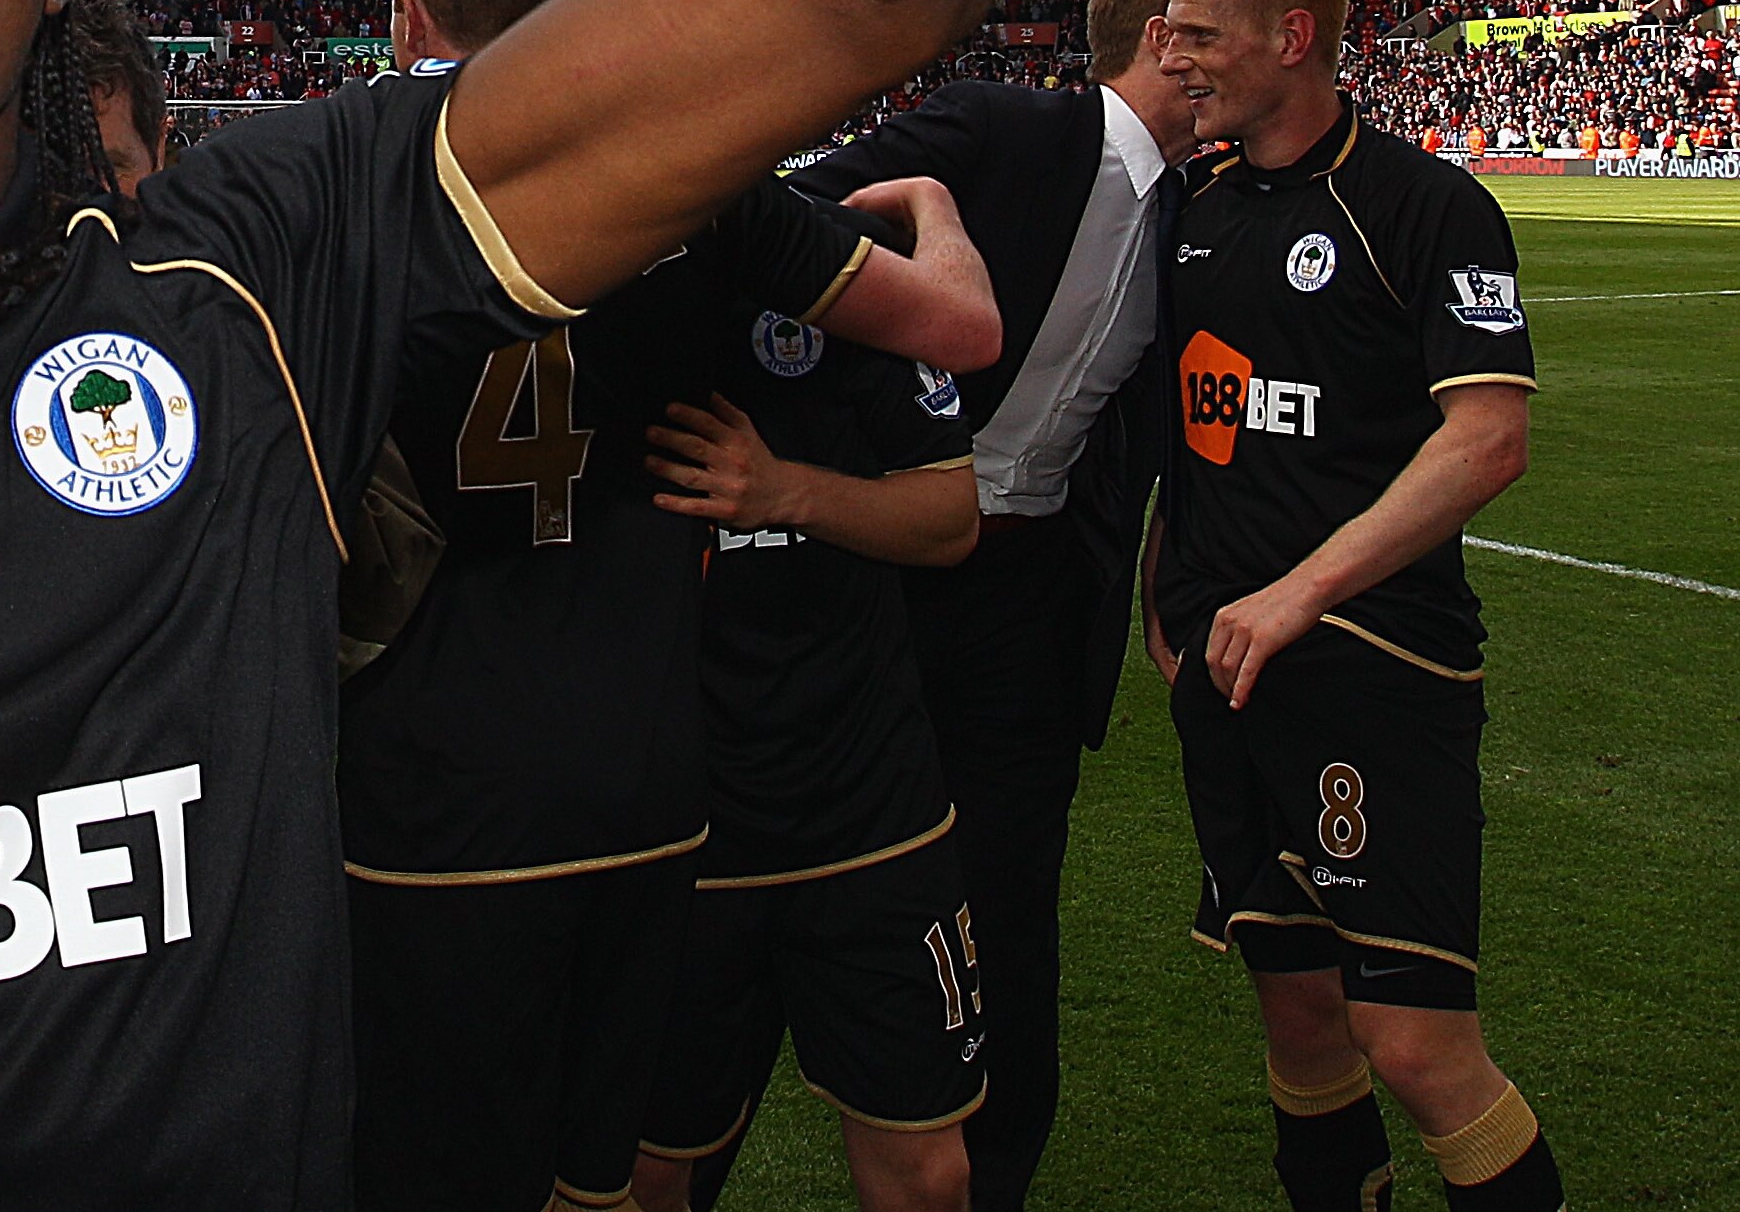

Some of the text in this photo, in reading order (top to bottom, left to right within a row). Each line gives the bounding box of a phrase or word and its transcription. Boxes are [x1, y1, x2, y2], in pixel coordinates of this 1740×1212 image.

[241, 26, 255, 36] 22
[1020, 28, 1035, 37] 25
[1486, 23, 1528, 37] Brown
[1595, 156, 1740, 178] PLAYER AWARD
[1464, 308, 1508, 317] BARCLAYS
[34, 338, 150, 383] WIGAN
[1187, 372, 1321, 437] 188BET
[457, 325, 595, 546] 4
[57, 448, 184, 503] ATHLETIC
[1318, 762, 1367, 859] 8
